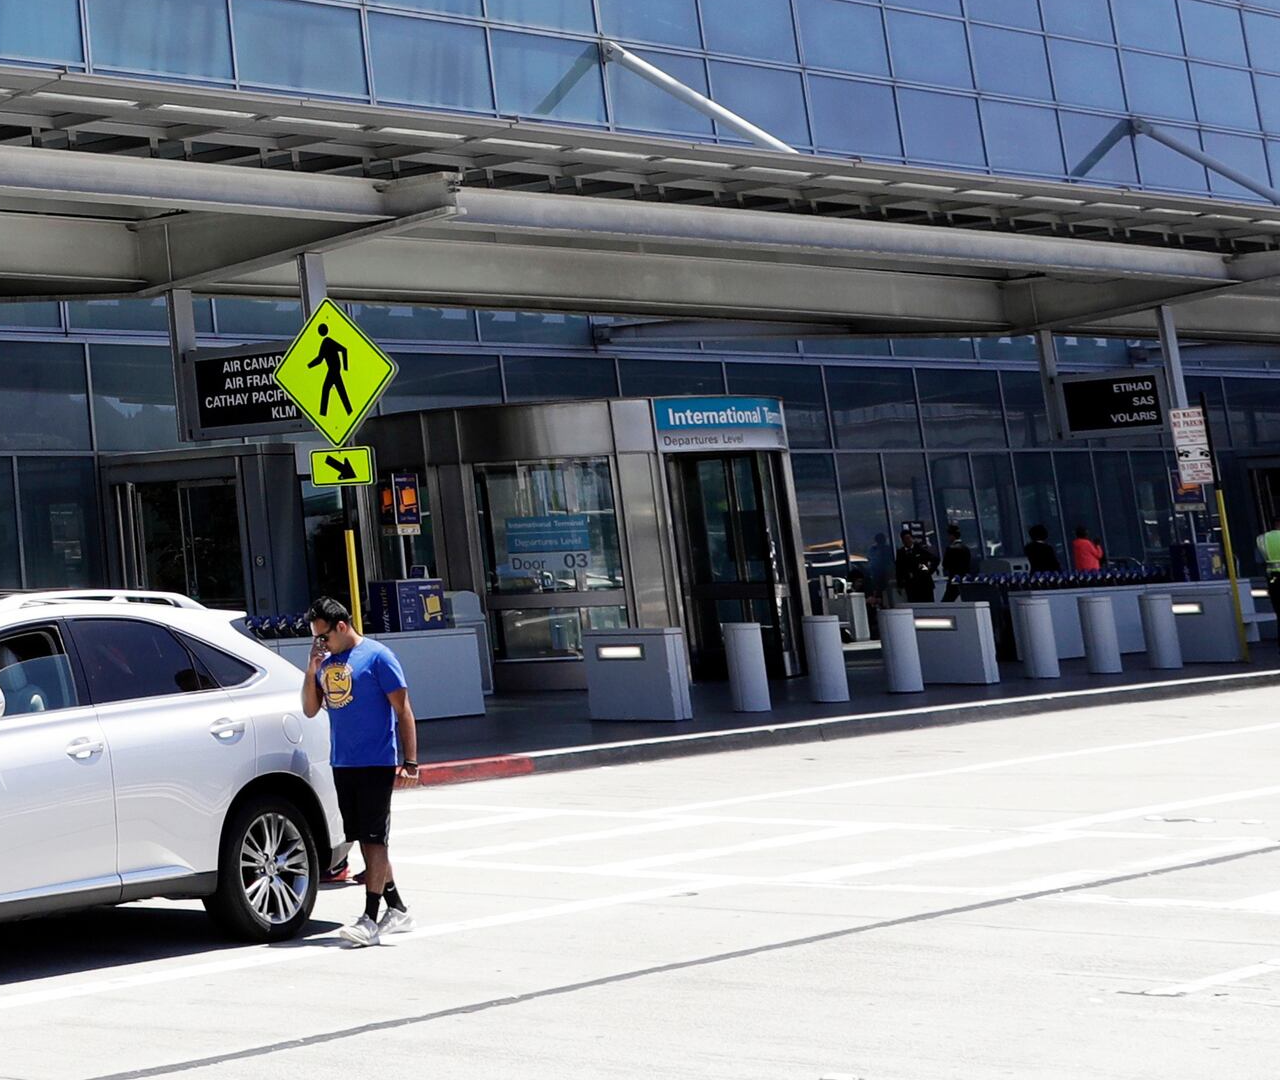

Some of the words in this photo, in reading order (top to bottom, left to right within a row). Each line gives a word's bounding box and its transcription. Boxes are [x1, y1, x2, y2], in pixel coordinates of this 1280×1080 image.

[222, 360, 241, 374] AIR
[243, 355, 283, 371] CANAD
[224, 376, 244, 390] AIR
[246, 373, 276, 388] FRAN
[1112, 381, 1153, 393] ETIHAD
[205, 392, 249, 408] CATHAY
[251, 389, 291, 404] PACIFI
[1132, 395, 1155, 406] SAS
[271, 405, 297, 419] KLM
[667, 406, 762, 426] International
[1110, 410, 1158, 423] VOLARIS
[663, 435, 719, 448] Departures
[722, 433, 744, 444] Level
[507, 521, 551, 529] International
[553, 519, 584, 527] Terminal
[514, 538, 558, 549] Departures
[560, 537, 582, 545] Level
[511, 558, 546, 570] Door
[564, 553, 588, 569] 03
[333, 671, 346, 681] 30
